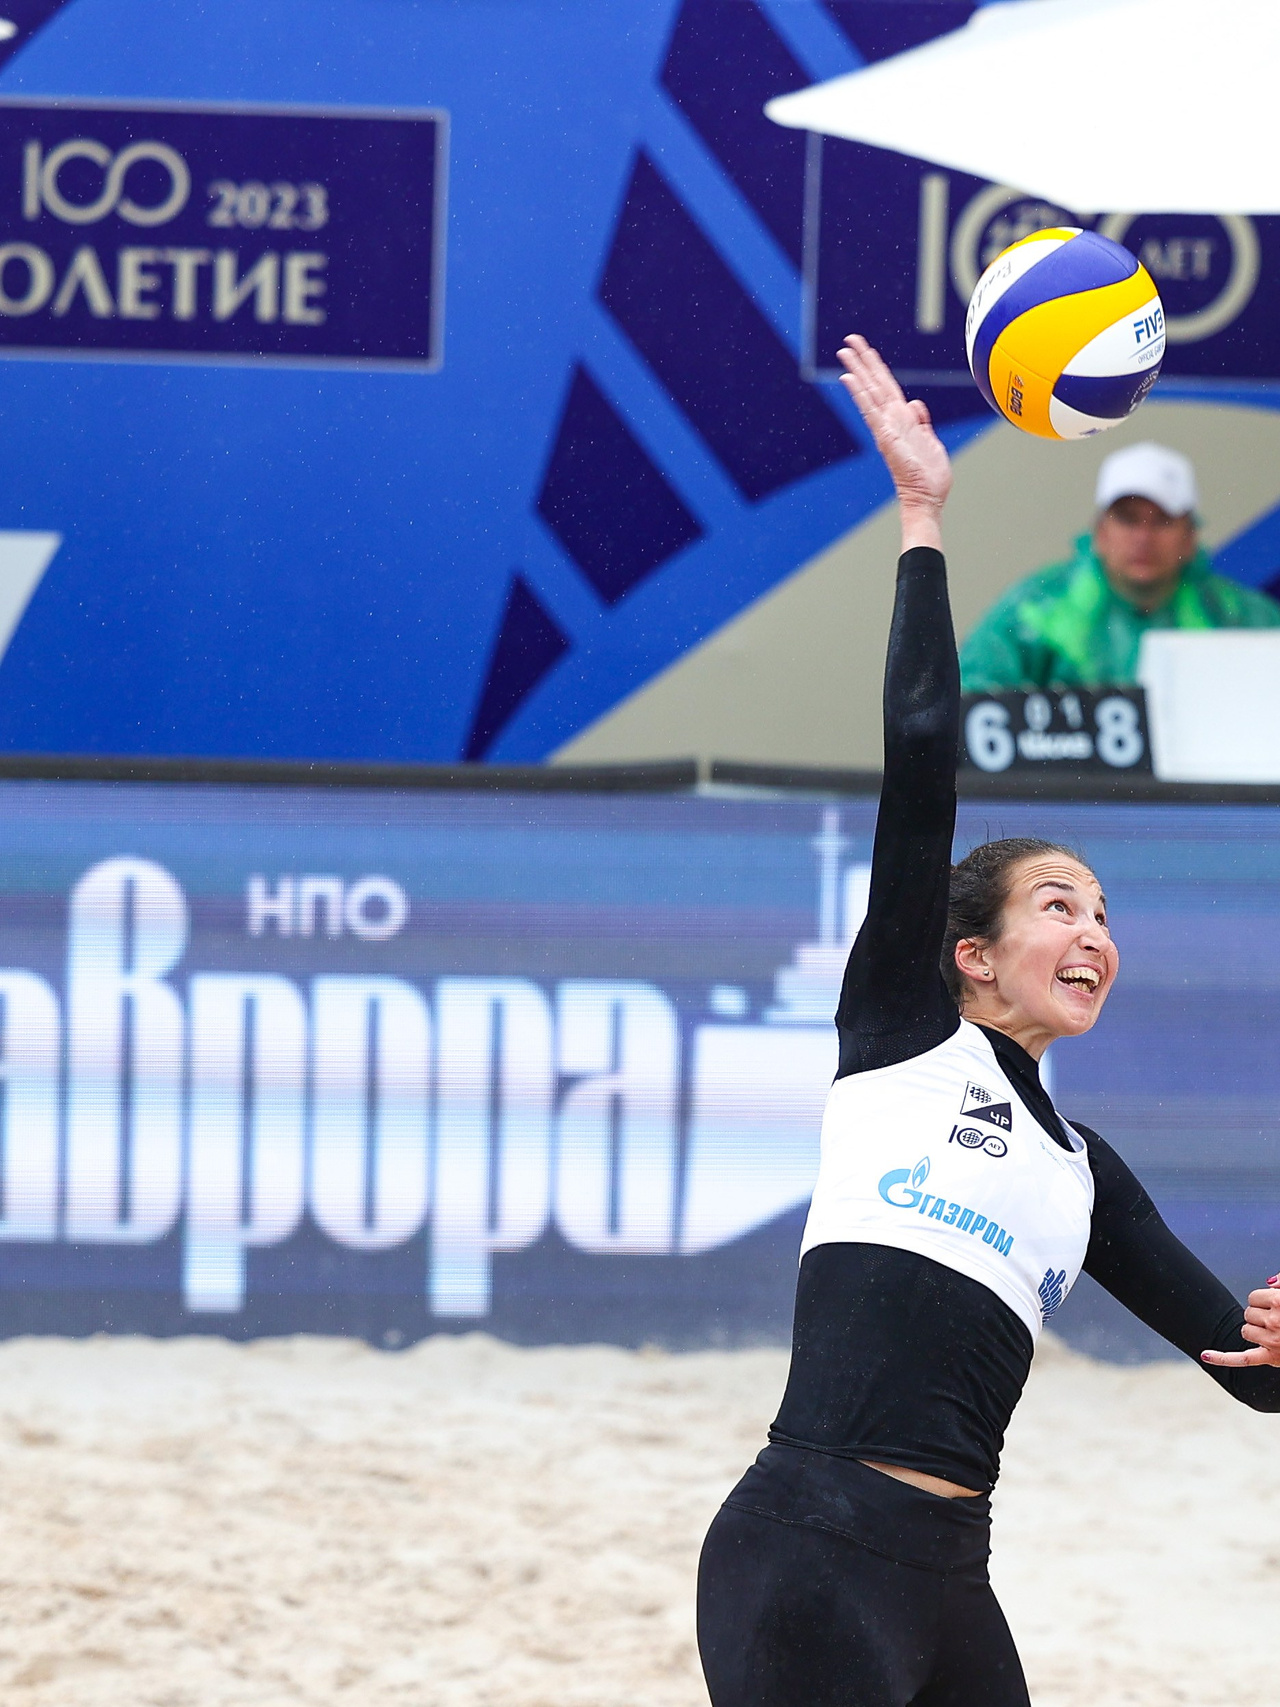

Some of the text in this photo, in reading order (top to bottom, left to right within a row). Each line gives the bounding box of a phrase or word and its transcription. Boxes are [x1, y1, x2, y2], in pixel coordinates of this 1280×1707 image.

[207, 180, 329, 231] 2023
[966, 701, 1016, 773] 6
[1094, 696, 1144, 768] 8
[246, 874, 409, 940] НПО
[990, 1111, 1010, 1126] ЧР
[918, 1193, 1014, 1257] ГАЗПРОМ
